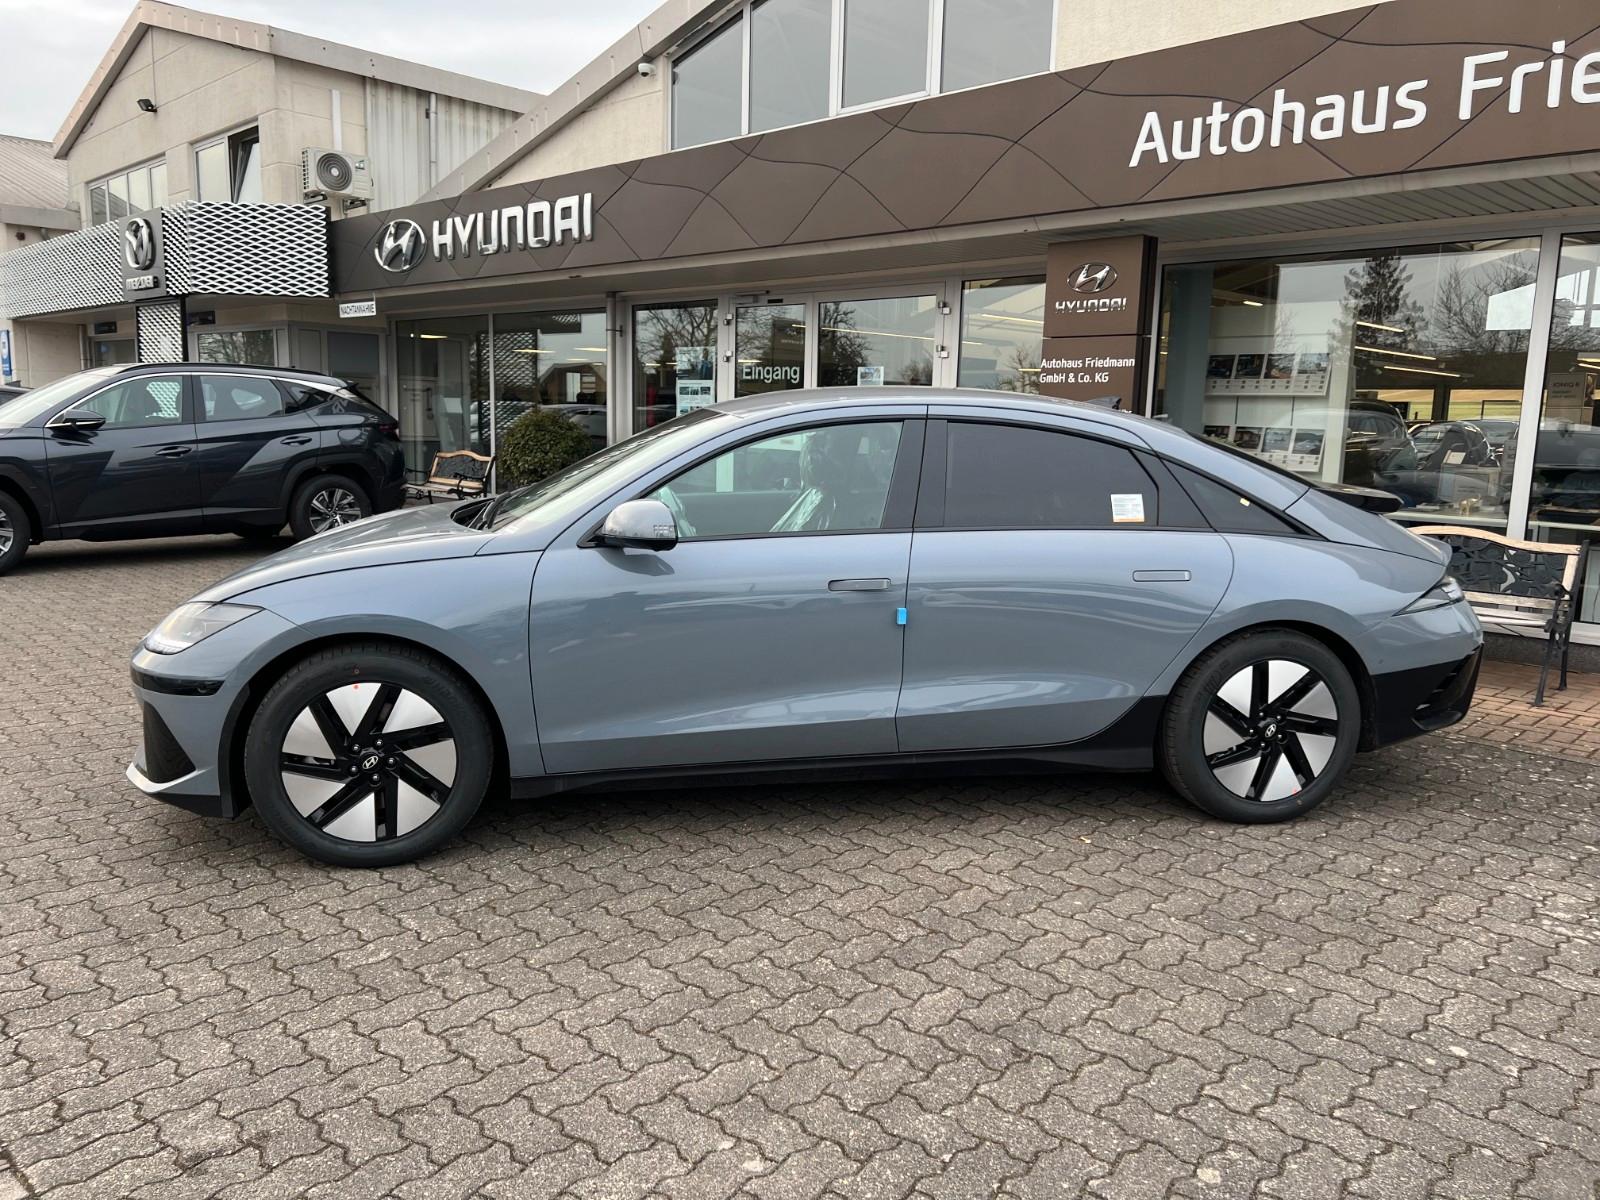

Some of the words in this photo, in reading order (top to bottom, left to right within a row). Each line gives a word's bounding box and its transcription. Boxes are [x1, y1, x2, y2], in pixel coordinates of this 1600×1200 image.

[1128, 79, 1429, 168] Autohaus
[432, 192, 593, 262] HYUNDAI
[1055, 297, 1127, 314] HYUNDAI
[1040, 358, 1083, 369] Autohaus
[1085, 357, 1135, 369] Friedmann
[742, 365, 800, 384] Eingang
[1039, 373, 1066, 383] GmbH
[1067, 373, 1076, 383] &
[1077, 372, 1093, 383] Co.
[1094, 372, 1109, 383] KG
